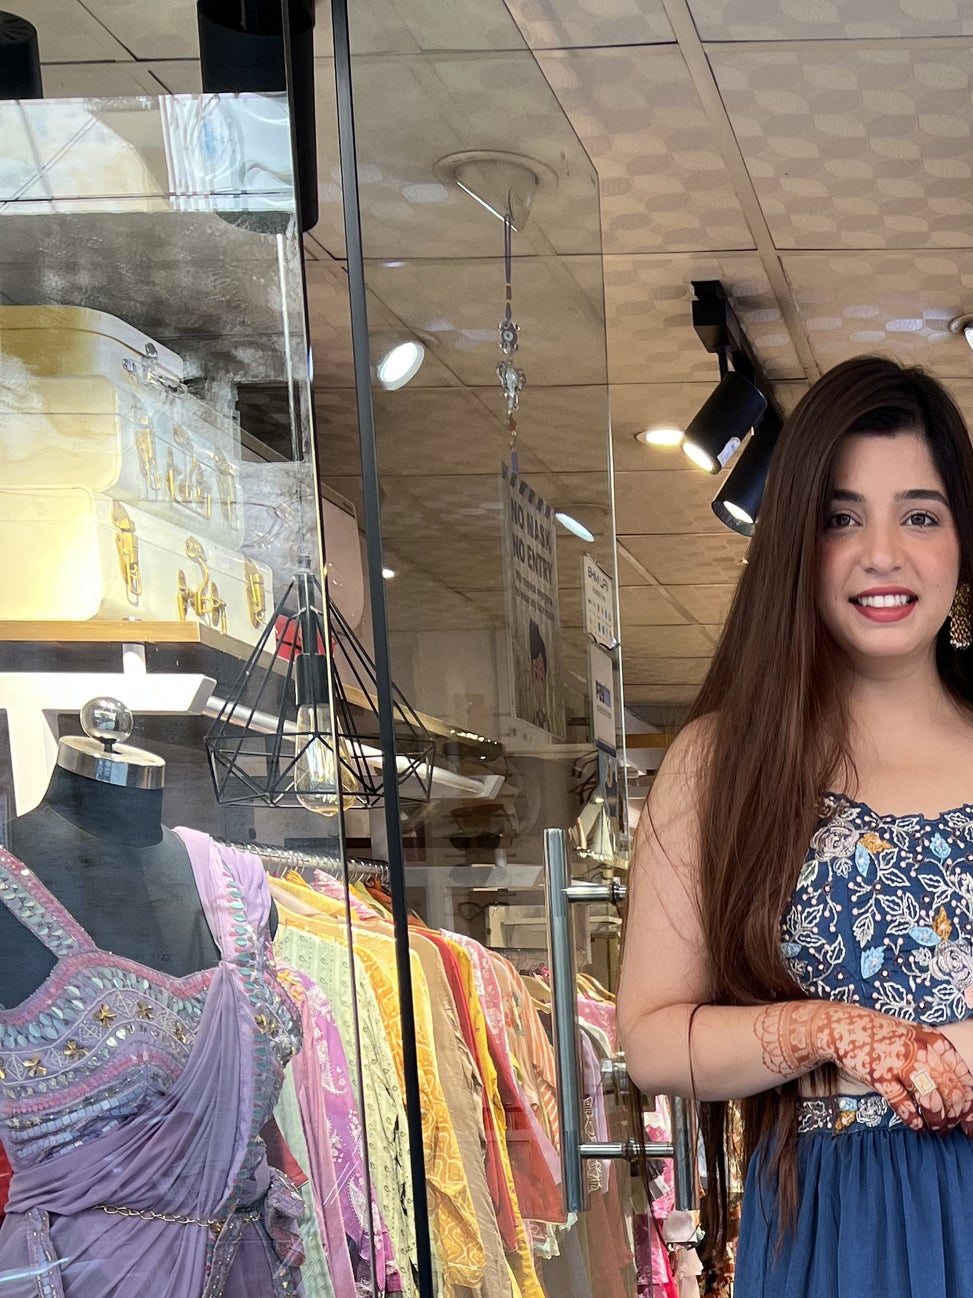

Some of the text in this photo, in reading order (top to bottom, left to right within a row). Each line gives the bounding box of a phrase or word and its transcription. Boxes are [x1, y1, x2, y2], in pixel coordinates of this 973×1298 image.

[510, 497, 552, 554] NO MASK
[511, 532, 553, 584] NO ENTRY
